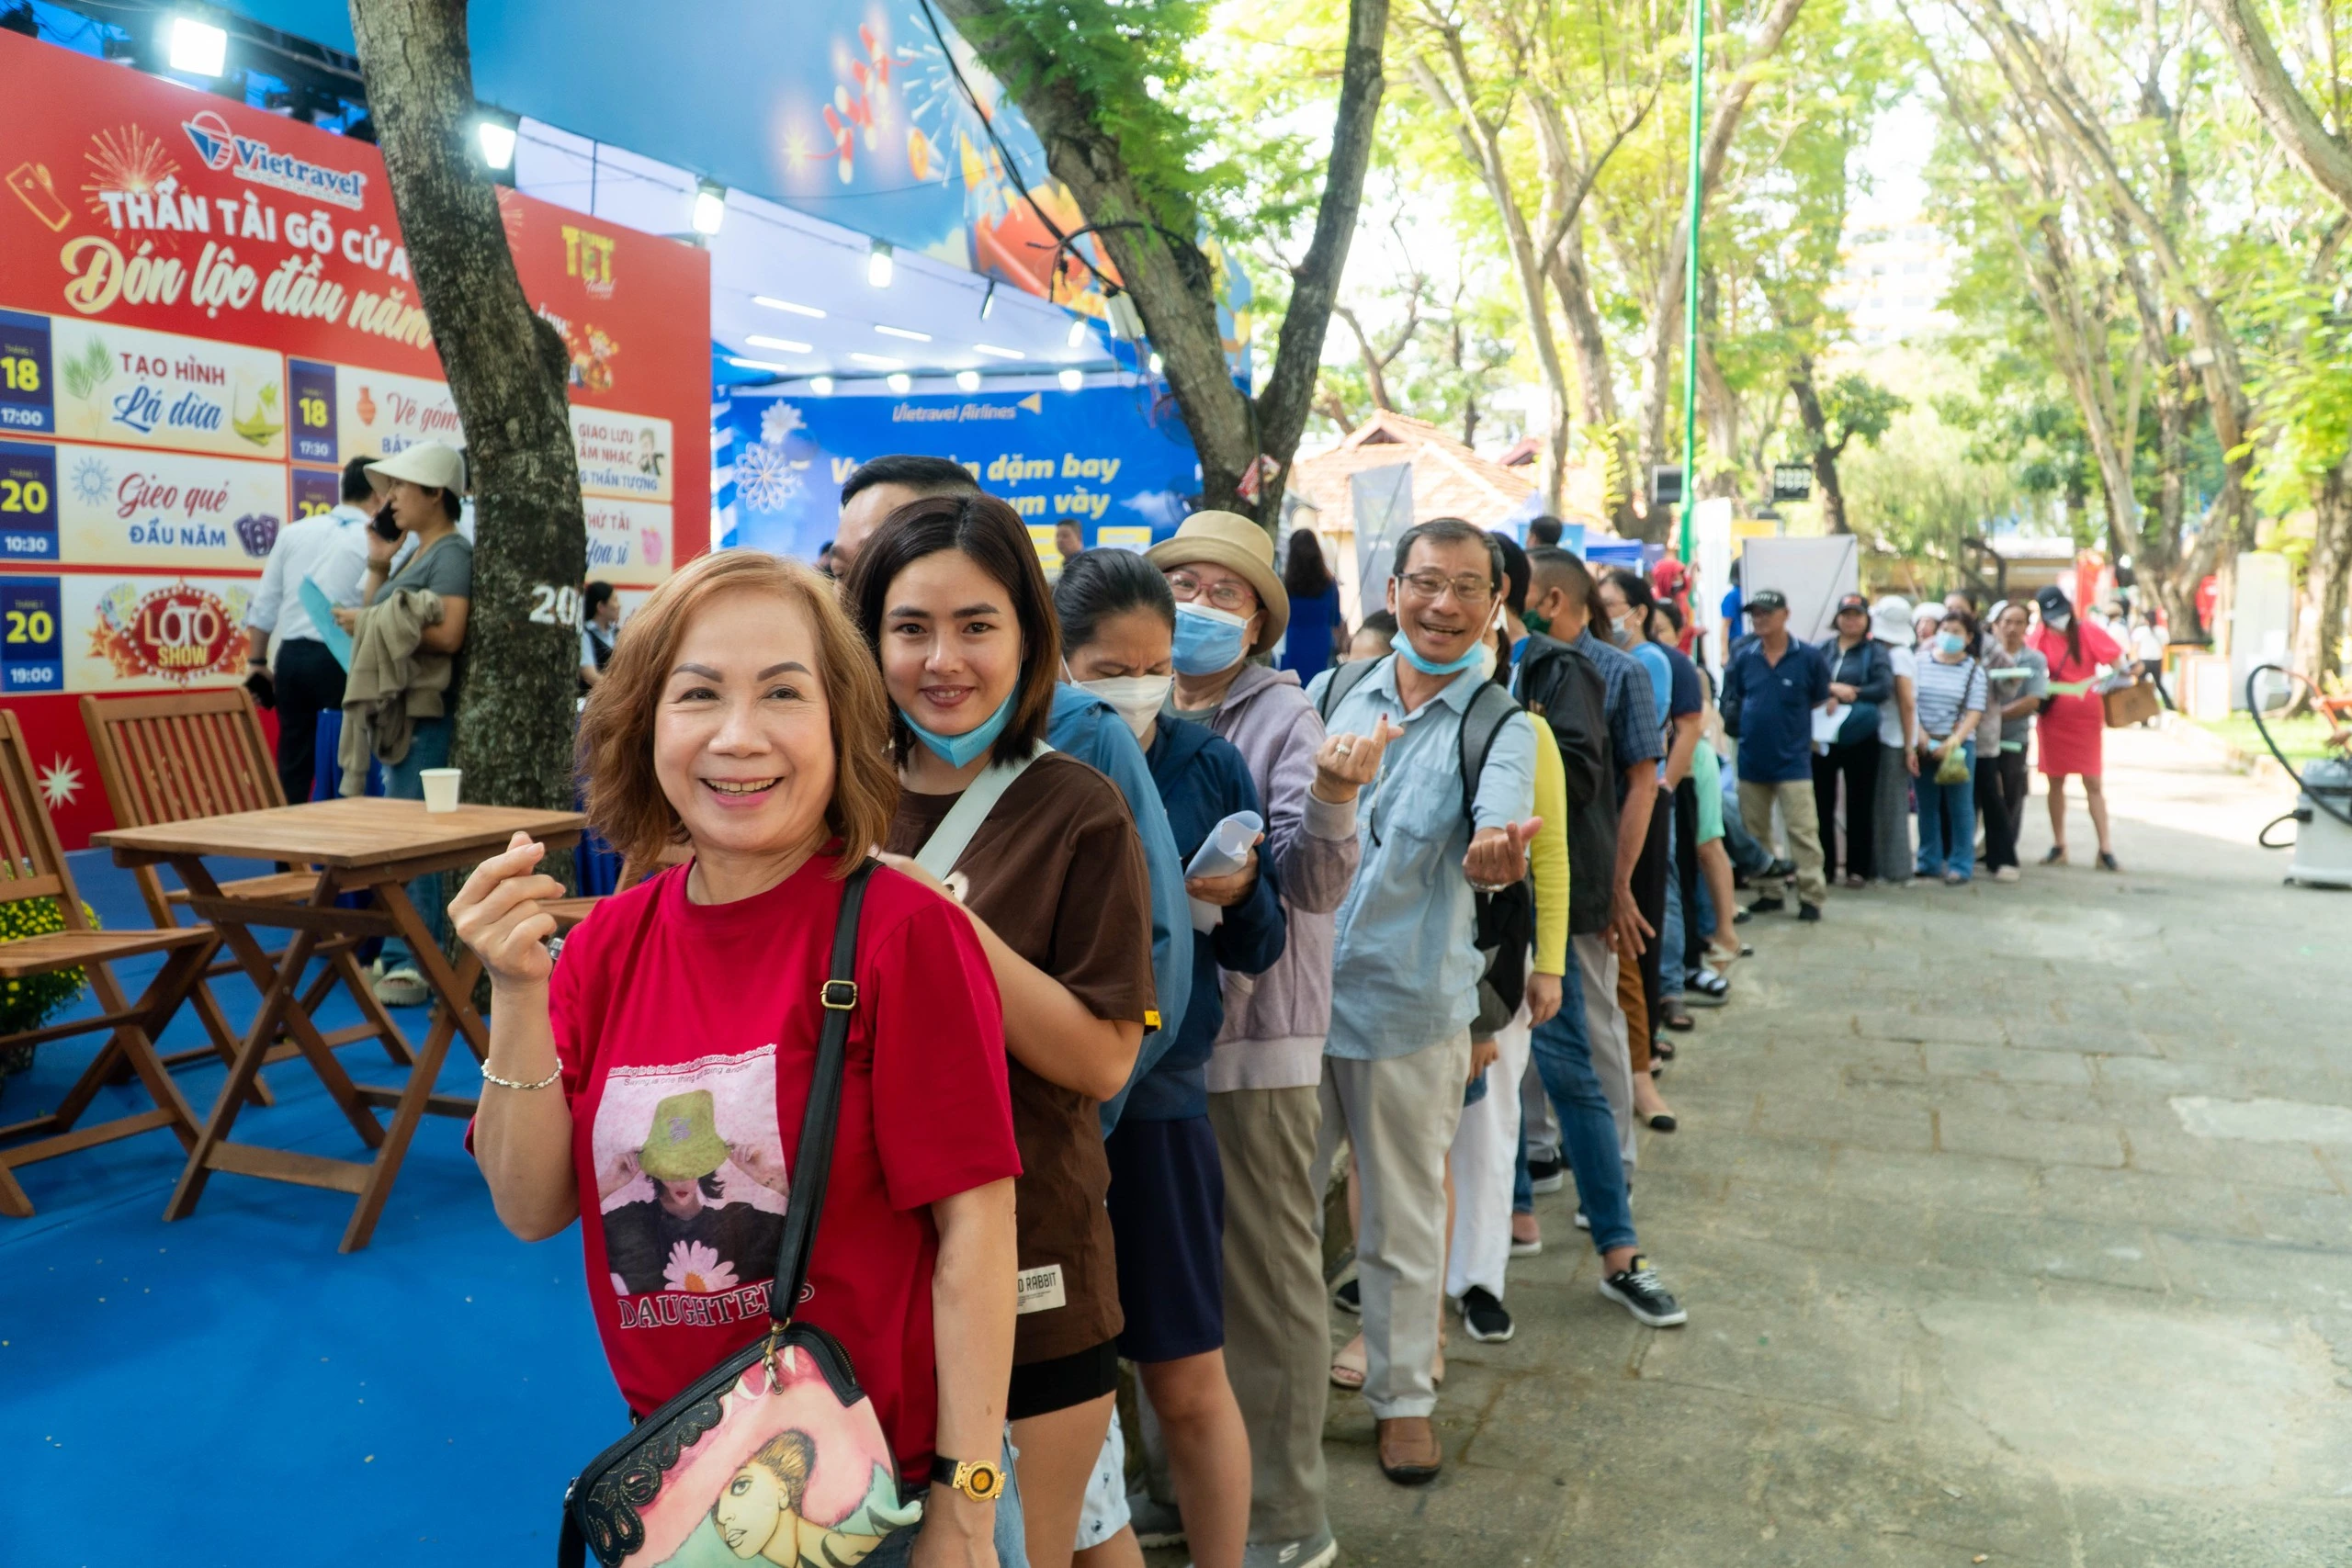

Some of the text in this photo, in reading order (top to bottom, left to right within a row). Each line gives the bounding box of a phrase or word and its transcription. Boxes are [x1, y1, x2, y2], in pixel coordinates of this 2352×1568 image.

[234, 137, 362, 197] Vietravel
[99, 174, 210, 232] THẦN
[215, 188, 277, 243] TÀI
[284, 209, 334, 254] GÕ
[342, 224, 410, 281] CỬA
[60, 235, 432, 350] Đón lộc đầu năm
[0, 356, 40, 392] 18
[119, 353, 225, 386] TẠO HÌNH
[1, 408, 43, 427] 17:00
[112, 385, 223, 434] Lá dừa
[299, 398, 328, 428] 18
[387, 391, 458, 434] Vẽ gốm
[892, 402, 1018, 423] Vietravel Airlines
[578, 423, 634, 445] GIAO LƯU
[601, 447, 633, 468] NHẠC
[987, 454, 1055, 487] dặm
[1060, 453, 1122, 484] bay
[591, 468, 618, 489] THẦN
[622, 473, 658, 493] TƯỢNG
[0, 479, 49, 514] 20
[118, 472, 230, 520] Gieo quẻ
[1054, 485, 1111, 520] vầy
[130, 517, 226, 547] ĐẦU NĂM
[586, 509, 630, 531] HỬ TÀI
[5, 536, 49, 553] 10:30
[6, 610, 53, 643] 20
[158, 646, 208, 667] SHOW
[10, 667, 53, 683] 19:00
[647, 1065, 655, 1074] to
[658, 1064, 670, 1074] the
[672, 1062, 689, 1073] mind
[701, 1054, 734, 1066] exercise
[678, 1073, 695, 1084] thing
[725, 1061, 753, 1075] another
[1026, 1271, 1057, 1292] RABBIT
